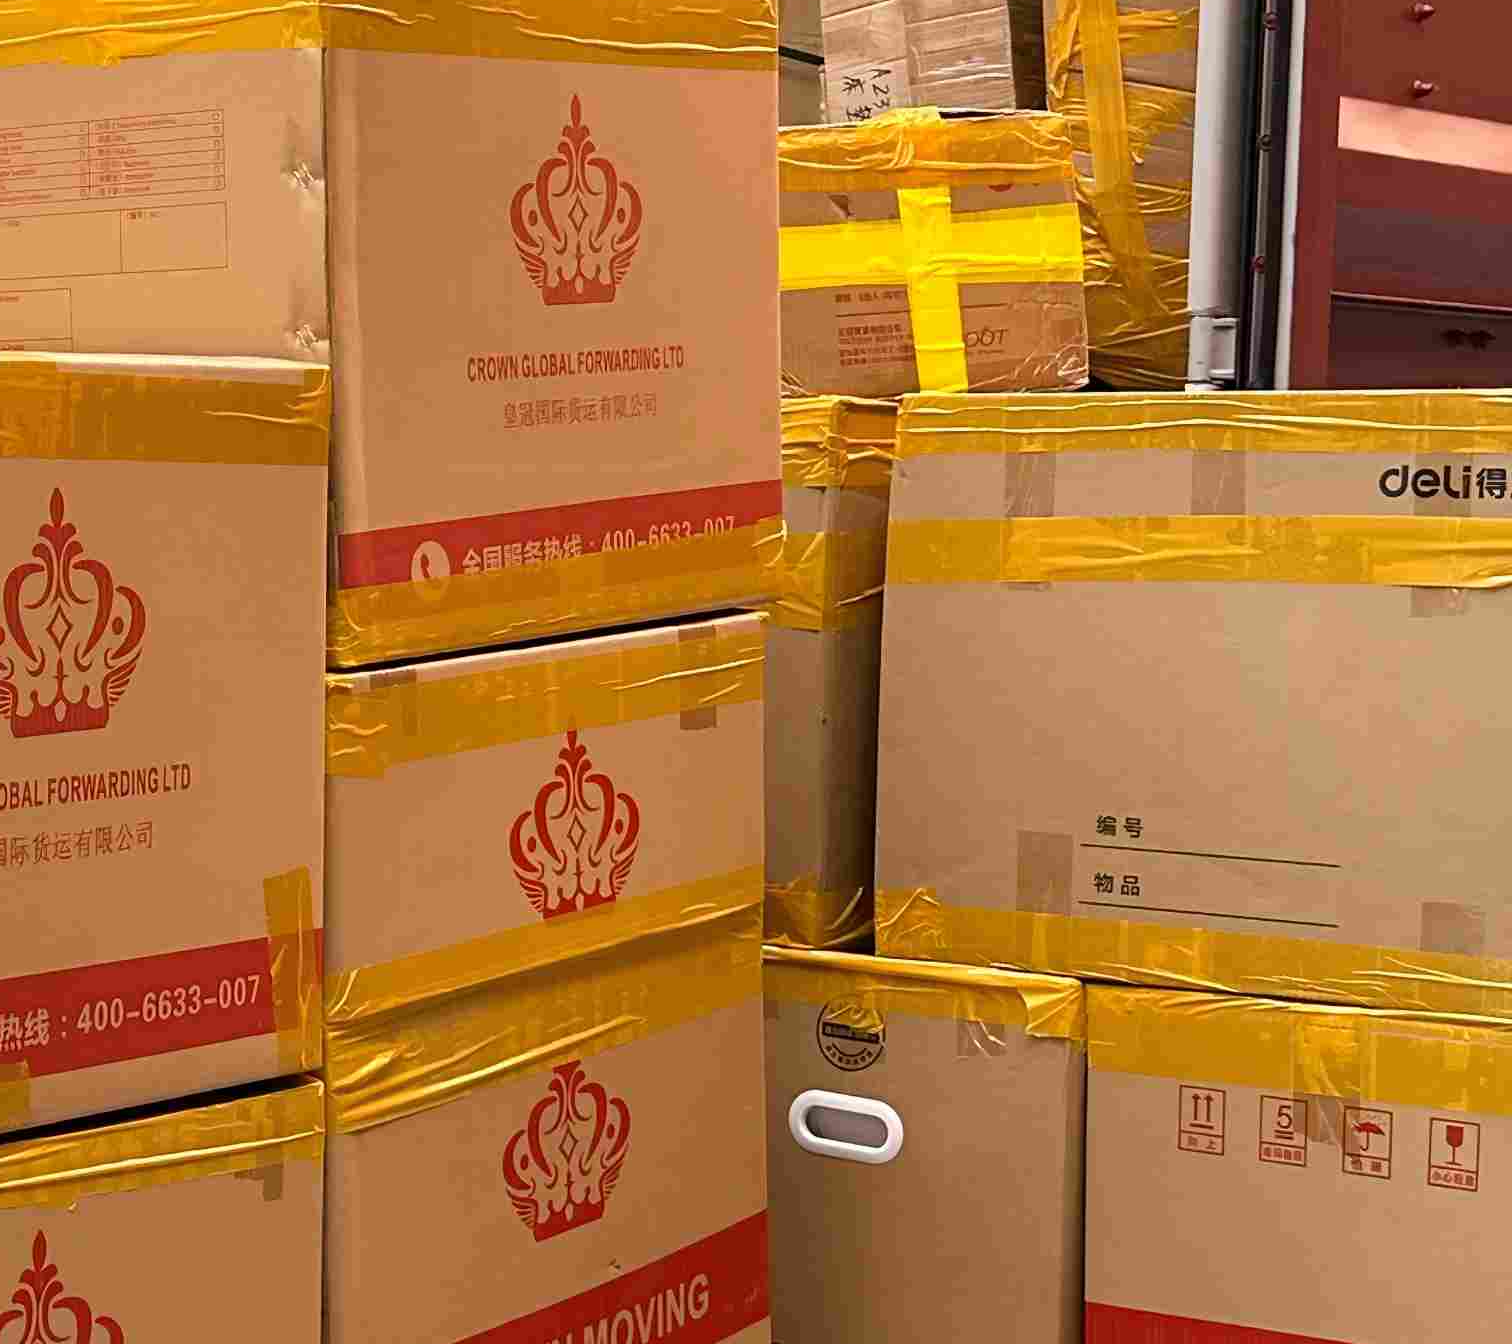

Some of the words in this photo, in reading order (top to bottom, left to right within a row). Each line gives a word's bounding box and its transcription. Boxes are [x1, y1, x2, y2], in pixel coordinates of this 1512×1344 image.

[466, 353, 520, 382] CROWN
[522, 350, 576, 378] GLOBAL
[577, 345, 661, 376] FORWARDING
[662, 345, 685, 369] LTD
[503, 392, 657, 430] 皇冠国际货运有限公司
[46, 767, 160, 807] FORWARDING
[162, 762, 192, 792] LTD
[1095, 815, 1144, 839] 编号
[1093, 871, 1141, 897] 物品
